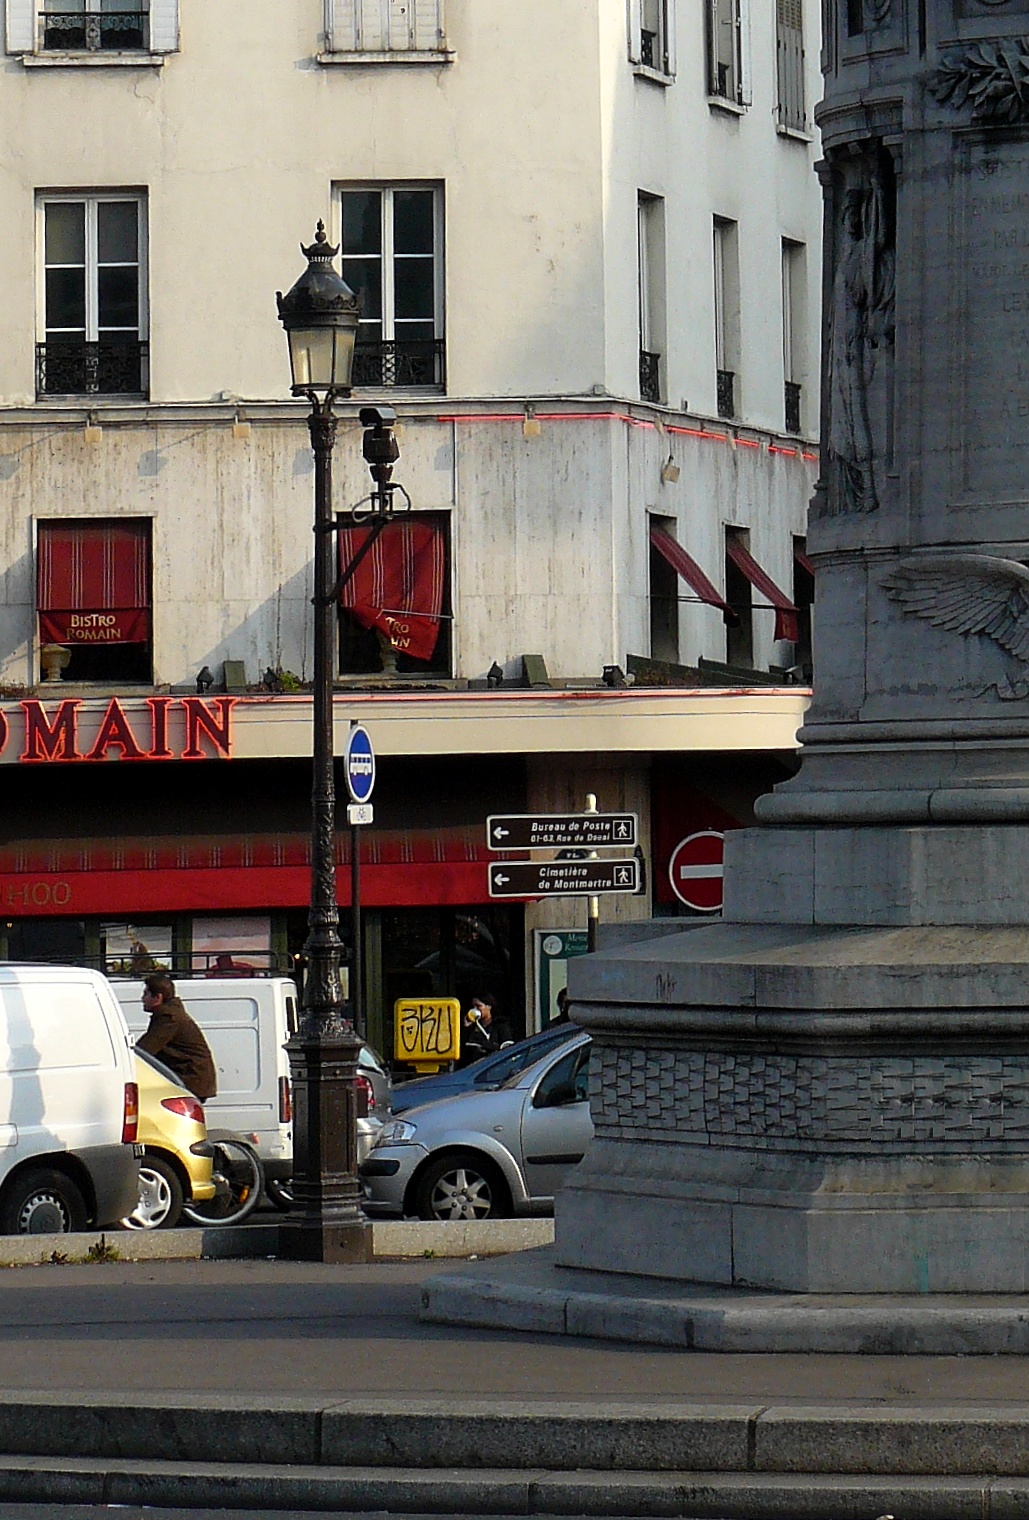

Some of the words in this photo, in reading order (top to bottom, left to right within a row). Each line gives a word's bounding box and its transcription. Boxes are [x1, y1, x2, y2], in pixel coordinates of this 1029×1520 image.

[70, 613, 116, 628] BISTRO
[66, 627, 121, 640] ROMAIN
[0, 696, 238, 762] MAIN
[531, 821, 567, 832] Bureau
[568, 820, 581, 832] de
[582, 820, 611, 831] Poste
[556, 833, 573, 843] Rue
[539, 865, 589, 878] Cimetière
[538, 879, 551, 890] de
[553, 878, 612, 889] Montmartre
